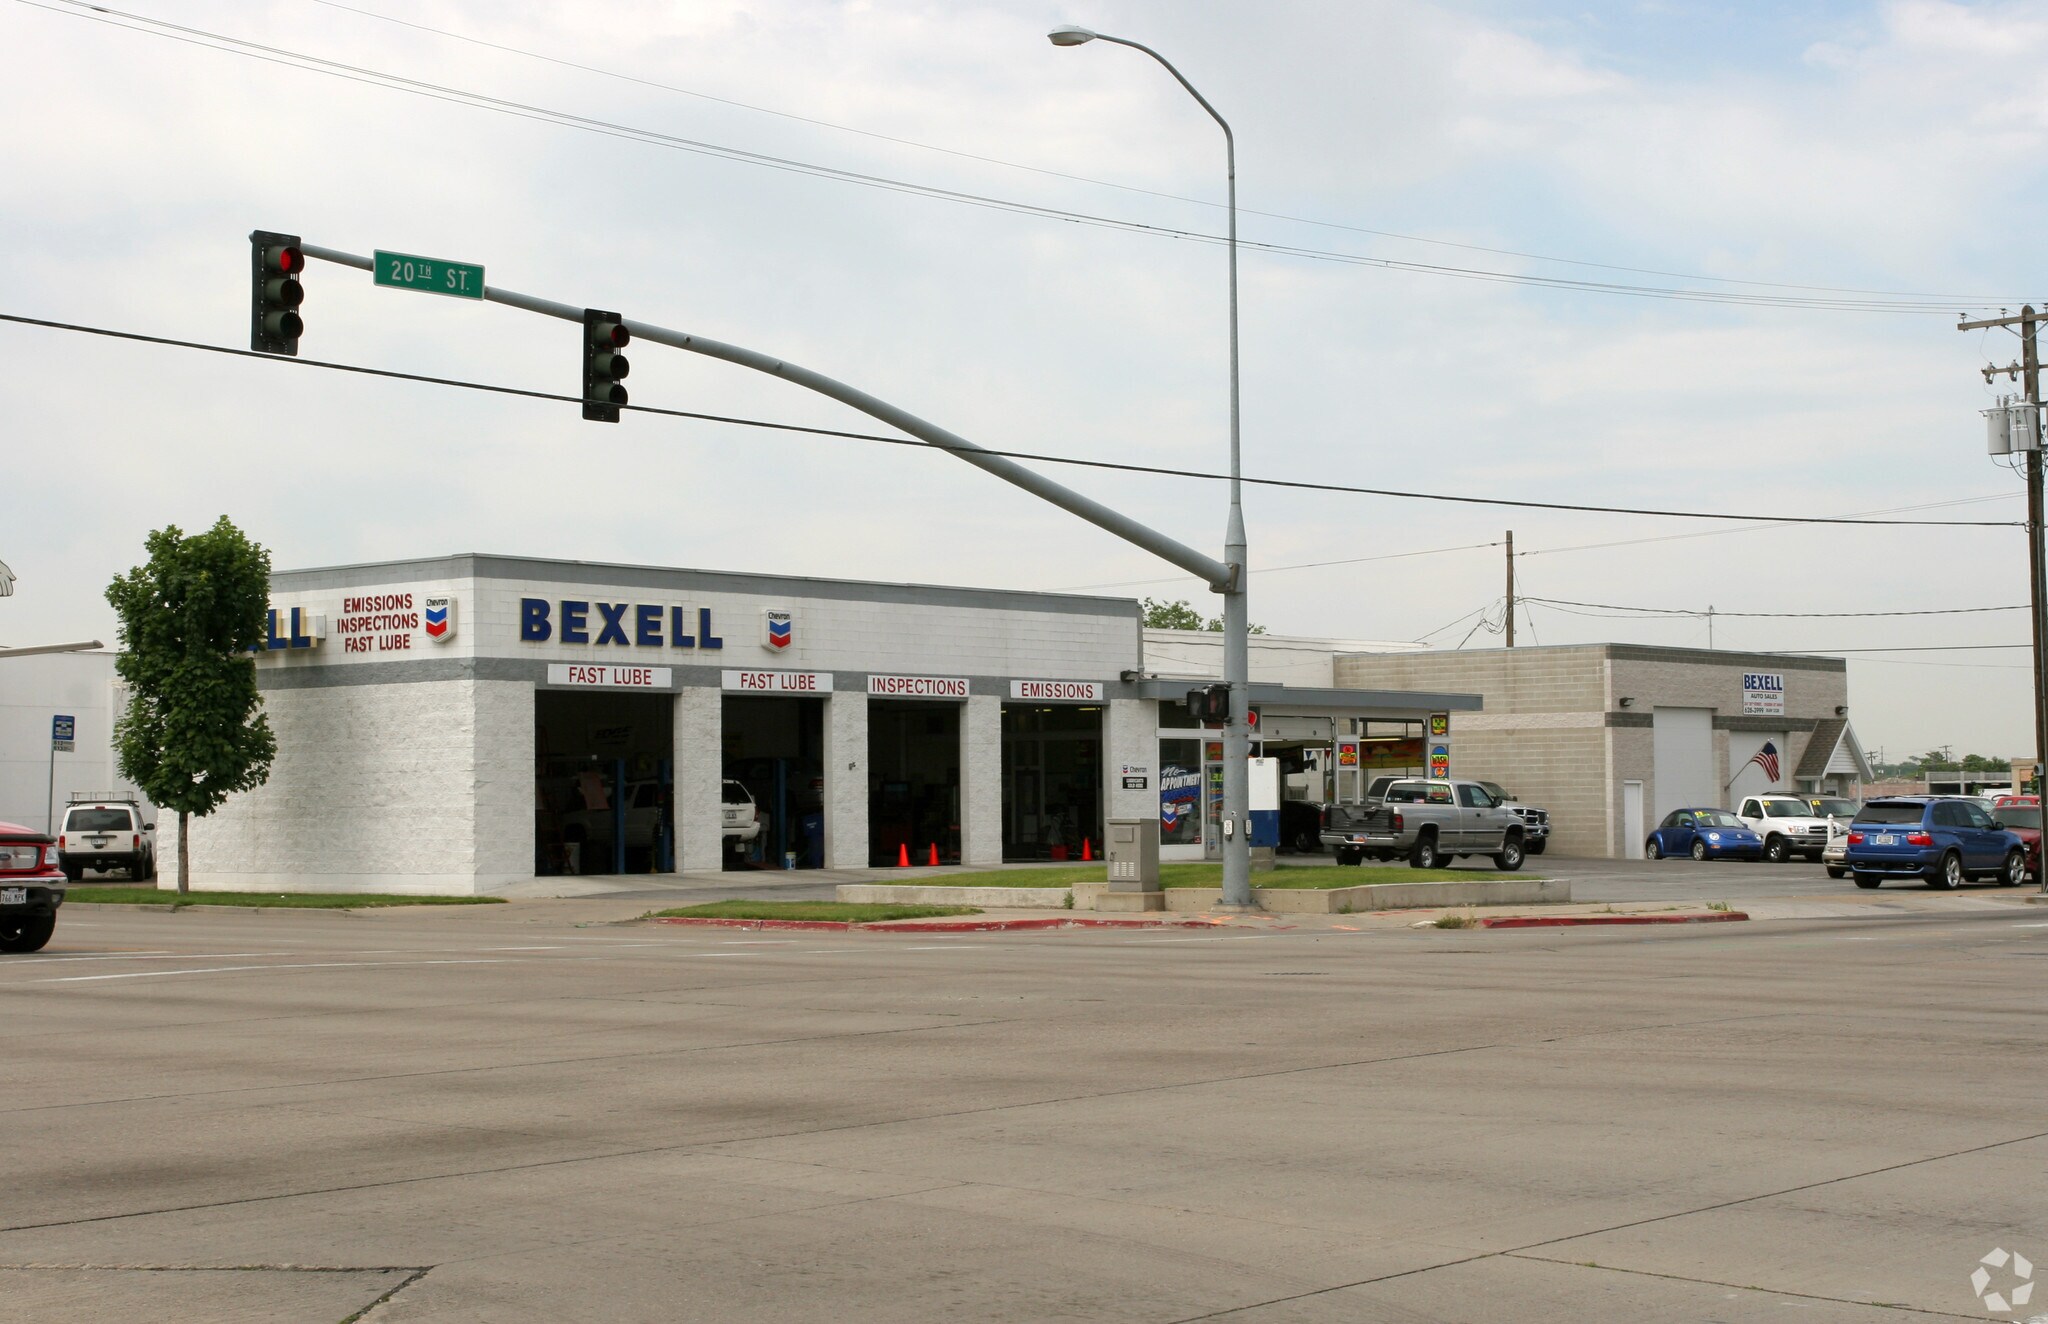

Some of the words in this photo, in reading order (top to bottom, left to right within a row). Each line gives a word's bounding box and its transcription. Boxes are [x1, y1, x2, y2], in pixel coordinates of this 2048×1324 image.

[344, 593, 413, 614] EMISSIONS
[426, 599, 449, 607] Chevron
[337, 613, 419, 634] INSPECTIONS
[520, 597, 723, 650] BEXELL
[768, 611, 791, 620] Chevron
[345, 636, 374, 653] FAST
[379, 634, 411, 651] LUBE
[568, 667, 607, 684] FAST
[613, 668, 653, 685] LUBE
[740, 673, 774, 689] FAST
[781, 674, 817, 691] LUBE
[1743, 674, 1783, 691] BEXELL
[871, 677, 966, 696] INSPECTIONS
[1021, 683, 1094, 699] EMISSIONS
[1160, 773, 1201, 791] APPOINTMENT
